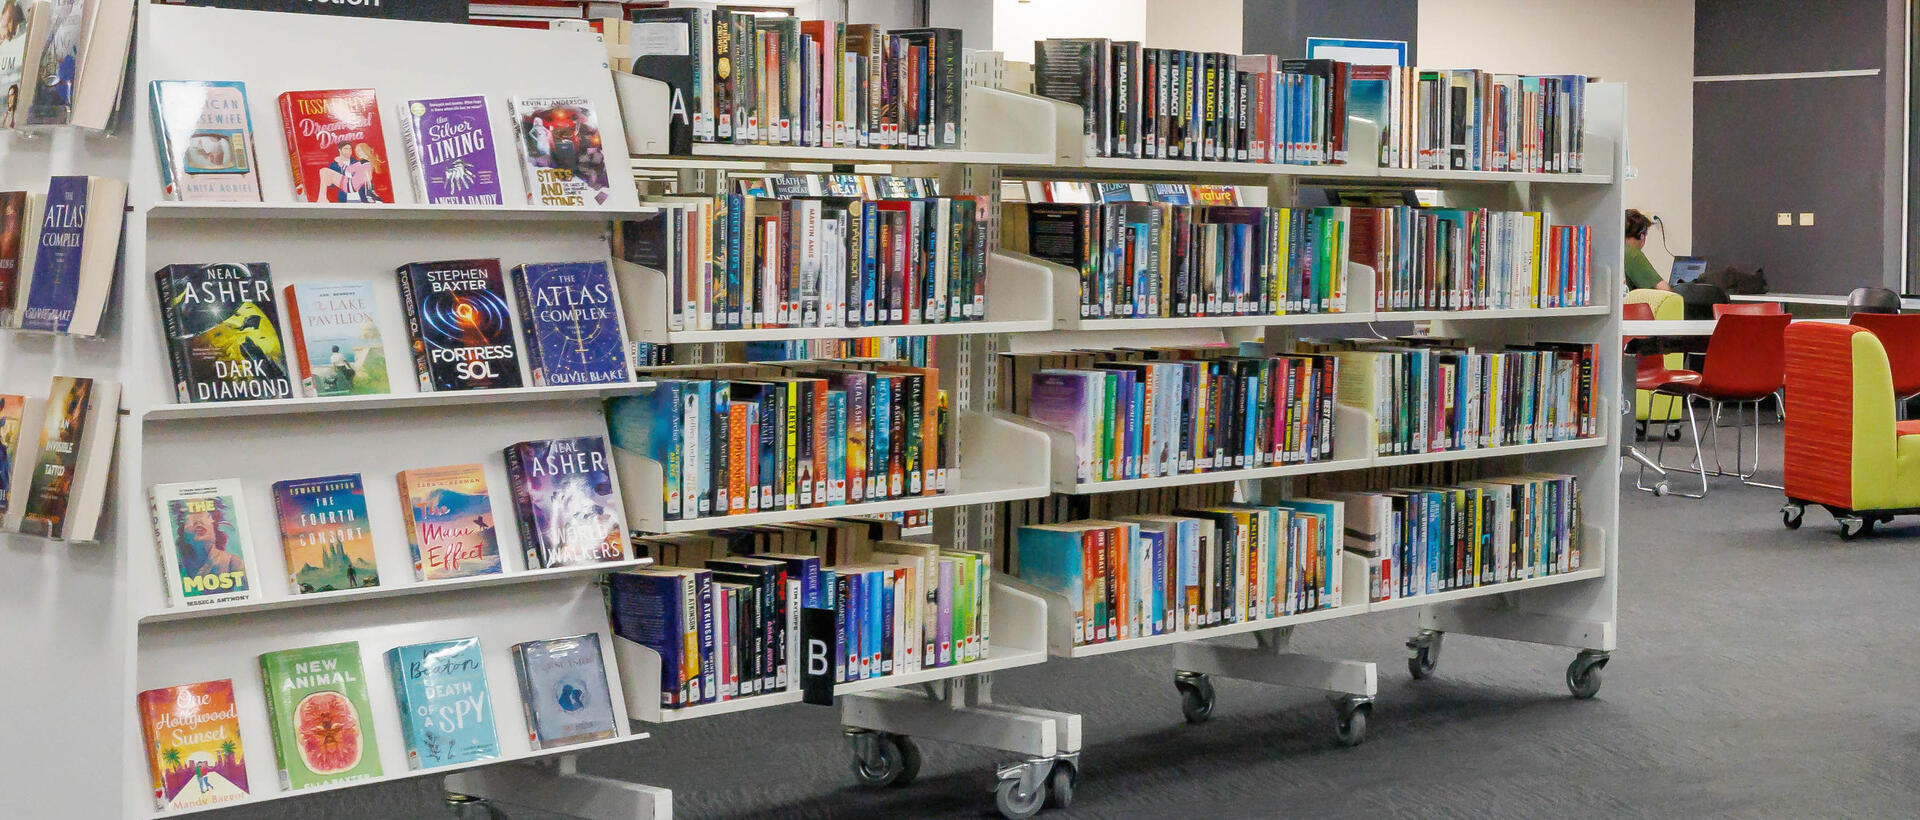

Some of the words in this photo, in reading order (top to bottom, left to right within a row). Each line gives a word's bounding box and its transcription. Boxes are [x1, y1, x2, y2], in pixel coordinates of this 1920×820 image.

[945, 56, 954, 104] KINDNESS
[551, 98, 588, 106] ANDERSON
[669, 87, 690, 126] A
[316, 130, 365, 150] Drama
[428, 120, 473, 142] Silver
[426, 128, 486, 166] LINING
[536, 168, 573, 183] STIFFS
[776, 177, 800, 186] DEATH
[186, 183, 215, 193] ANITA
[540, 182, 563, 196] AND
[1200, 190, 1232, 202] rature
[541, 196, 585, 206] STONES
[44, 204, 85, 228] ATLAS
[732, 197, 740, 233] OTHER
[42, 232, 81, 247] COMPLEX
[731, 238, 740, 269] BIRDS
[207, 268, 240, 281] NEAL
[426, 268, 489, 282] STEPHEN
[558, 273, 576, 284] THE
[183, 280, 271, 304] ASHER
[432, 279, 487, 293] BAXTER
[536, 283, 609, 307] ATLAS
[329, 298, 368, 312] LAKE
[400, 270, 416, 317] FORTRESS
[409, 317, 419, 337] SOL
[307, 312, 373, 328] PAVILION
[540, 306, 611, 323] COMPLEX
[431, 345, 514, 363] FORTRESS
[215, 359, 266, 379] DARK
[456, 360, 499, 380] SOL
[550, 371, 587, 384] OLIVIE
[588, 368, 625, 381] BLAKE
[198, 378, 290, 400] DIAMOND
[854, 379, 863, 402] NEAL
[671, 386, 680, 413] Jeffrey
[672, 415, 680, 441] Archer
[719, 414, 728, 439] Jeffrey
[854, 404, 863, 432] ASHER
[531, 451, 606, 477] ASHER
[719, 441, 728, 468] Archer
[184, 499, 216, 513] THE
[315, 496, 335, 508] THE
[417, 501, 451, 519] The
[300, 508, 355, 527] FOURTH
[299, 527, 363, 547] CONSORT
[421, 521, 475, 545] Maui
[553, 523, 608, 545] WORLD
[427, 540, 486, 571] Effect
[543, 541, 621, 568] WALKERS
[182, 571, 245, 593] MOST
[687, 579, 695, 597] KATE
[703, 577, 711, 600] KATE
[216, 594, 250, 604] ANTHONY
[687, 598, 696, 631] ATKINSON
[703, 603, 712, 648] ATKINSON
[295, 657, 338, 674] NEW
[807, 638, 829, 676] B
[281, 670, 357, 691] ANIMAL
[424, 680, 473, 700] DEATH
[175, 688, 211, 708] One
[155, 703, 238, 731] Hollywood
[417, 705, 436, 717] OF
[439, 690, 485, 733] SPY
[424, 716, 434, 728] A
[171, 724, 227, 748] Sunset
[172, 795, 209, 811] Mandy
